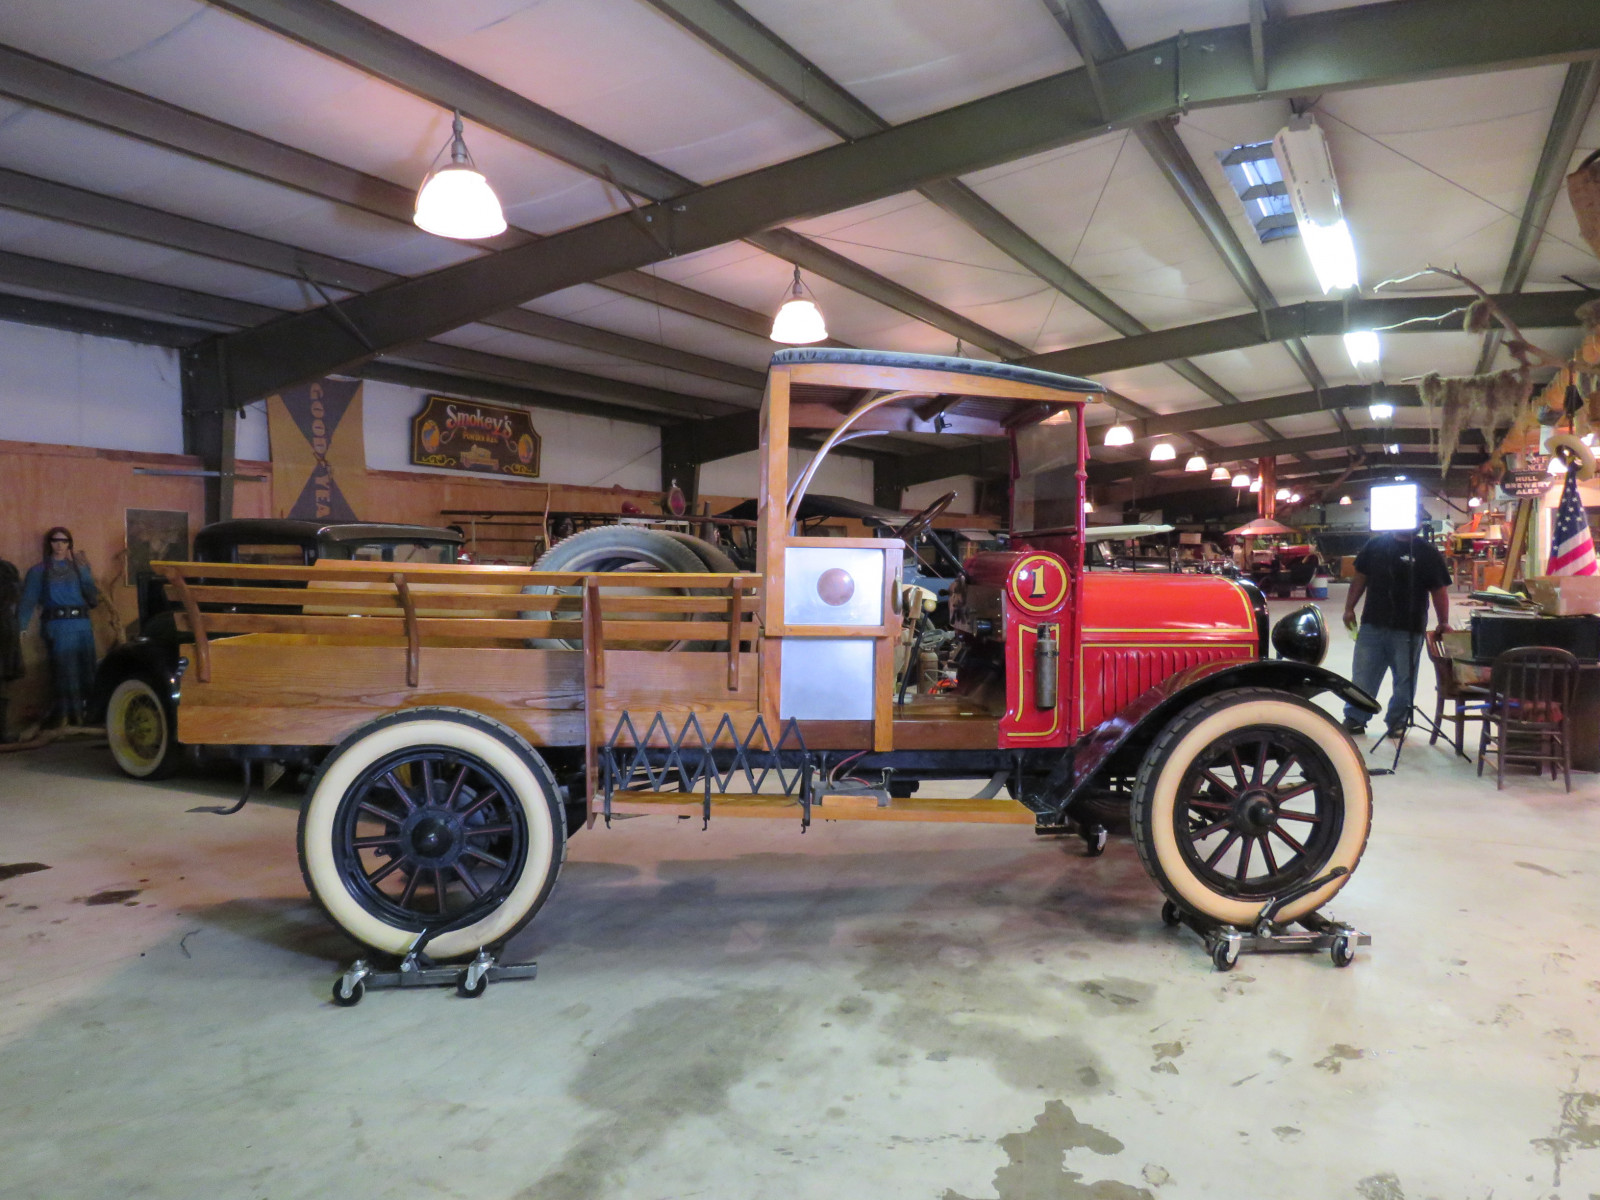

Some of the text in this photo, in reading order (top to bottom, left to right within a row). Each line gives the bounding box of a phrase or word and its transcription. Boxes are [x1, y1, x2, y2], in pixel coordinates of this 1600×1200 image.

[446, 404, 513, 439] Smokey's
[309, 382, 332, 519] GOODYEA
[1504, 481, 1551, 489] BREWERY
[1031, 564, 1047, 595] 1
